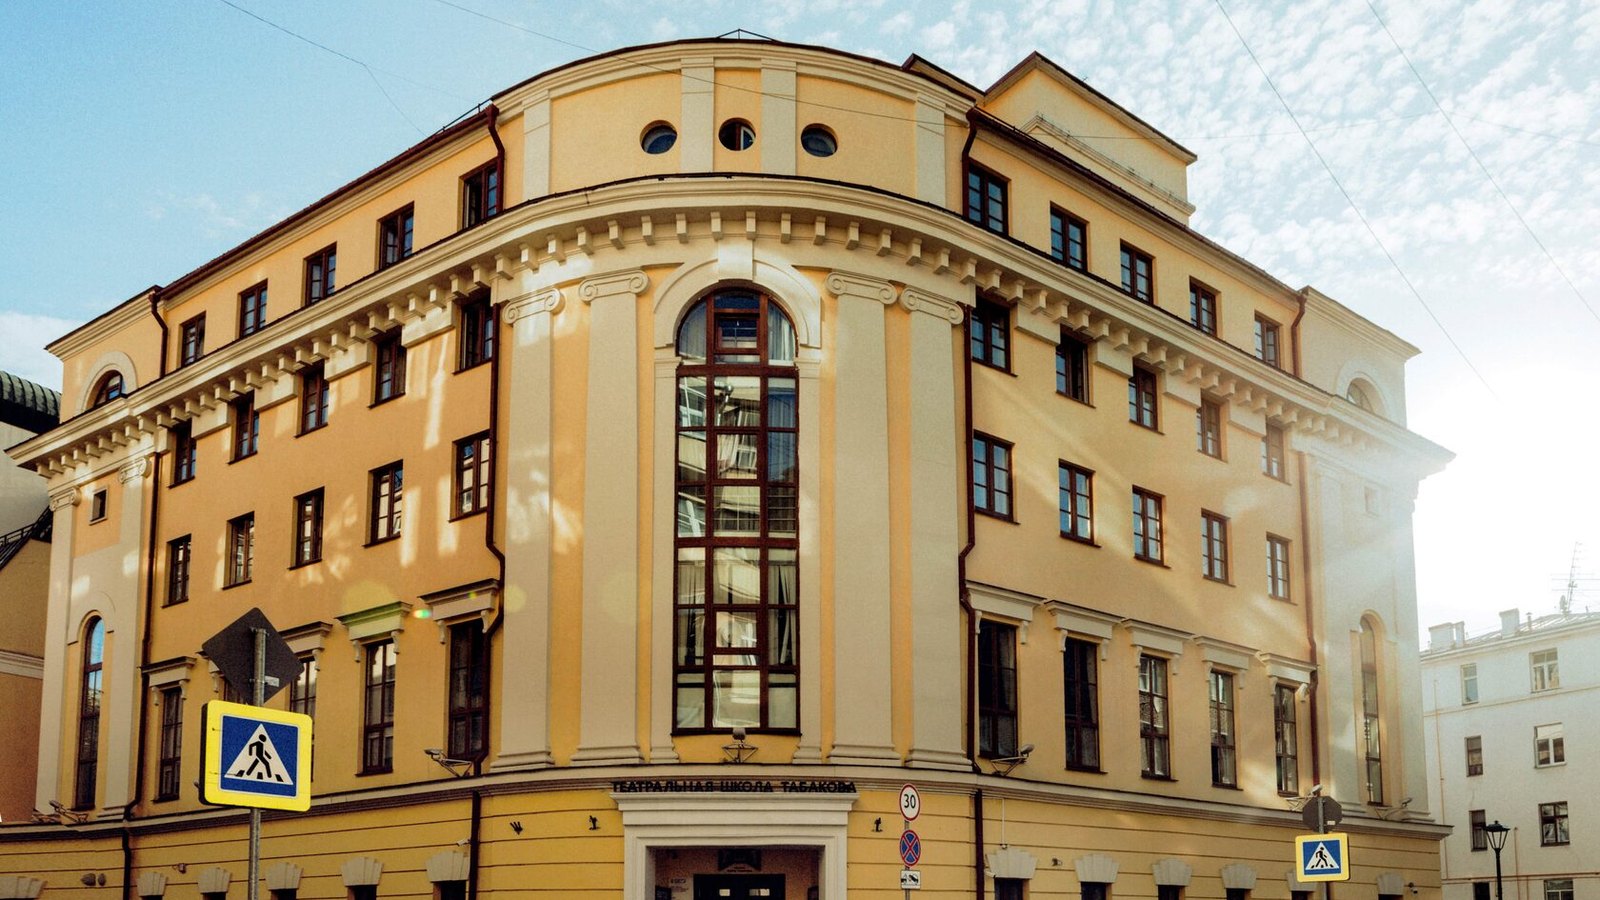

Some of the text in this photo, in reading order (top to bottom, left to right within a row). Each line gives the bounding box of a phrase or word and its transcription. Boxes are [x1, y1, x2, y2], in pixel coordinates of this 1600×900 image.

[612, 780, 857, 793] ТЕАТРАЛЬНАЯ ШКОЛА ТАБАКОВА
[904, 794, 916, 809] 30
